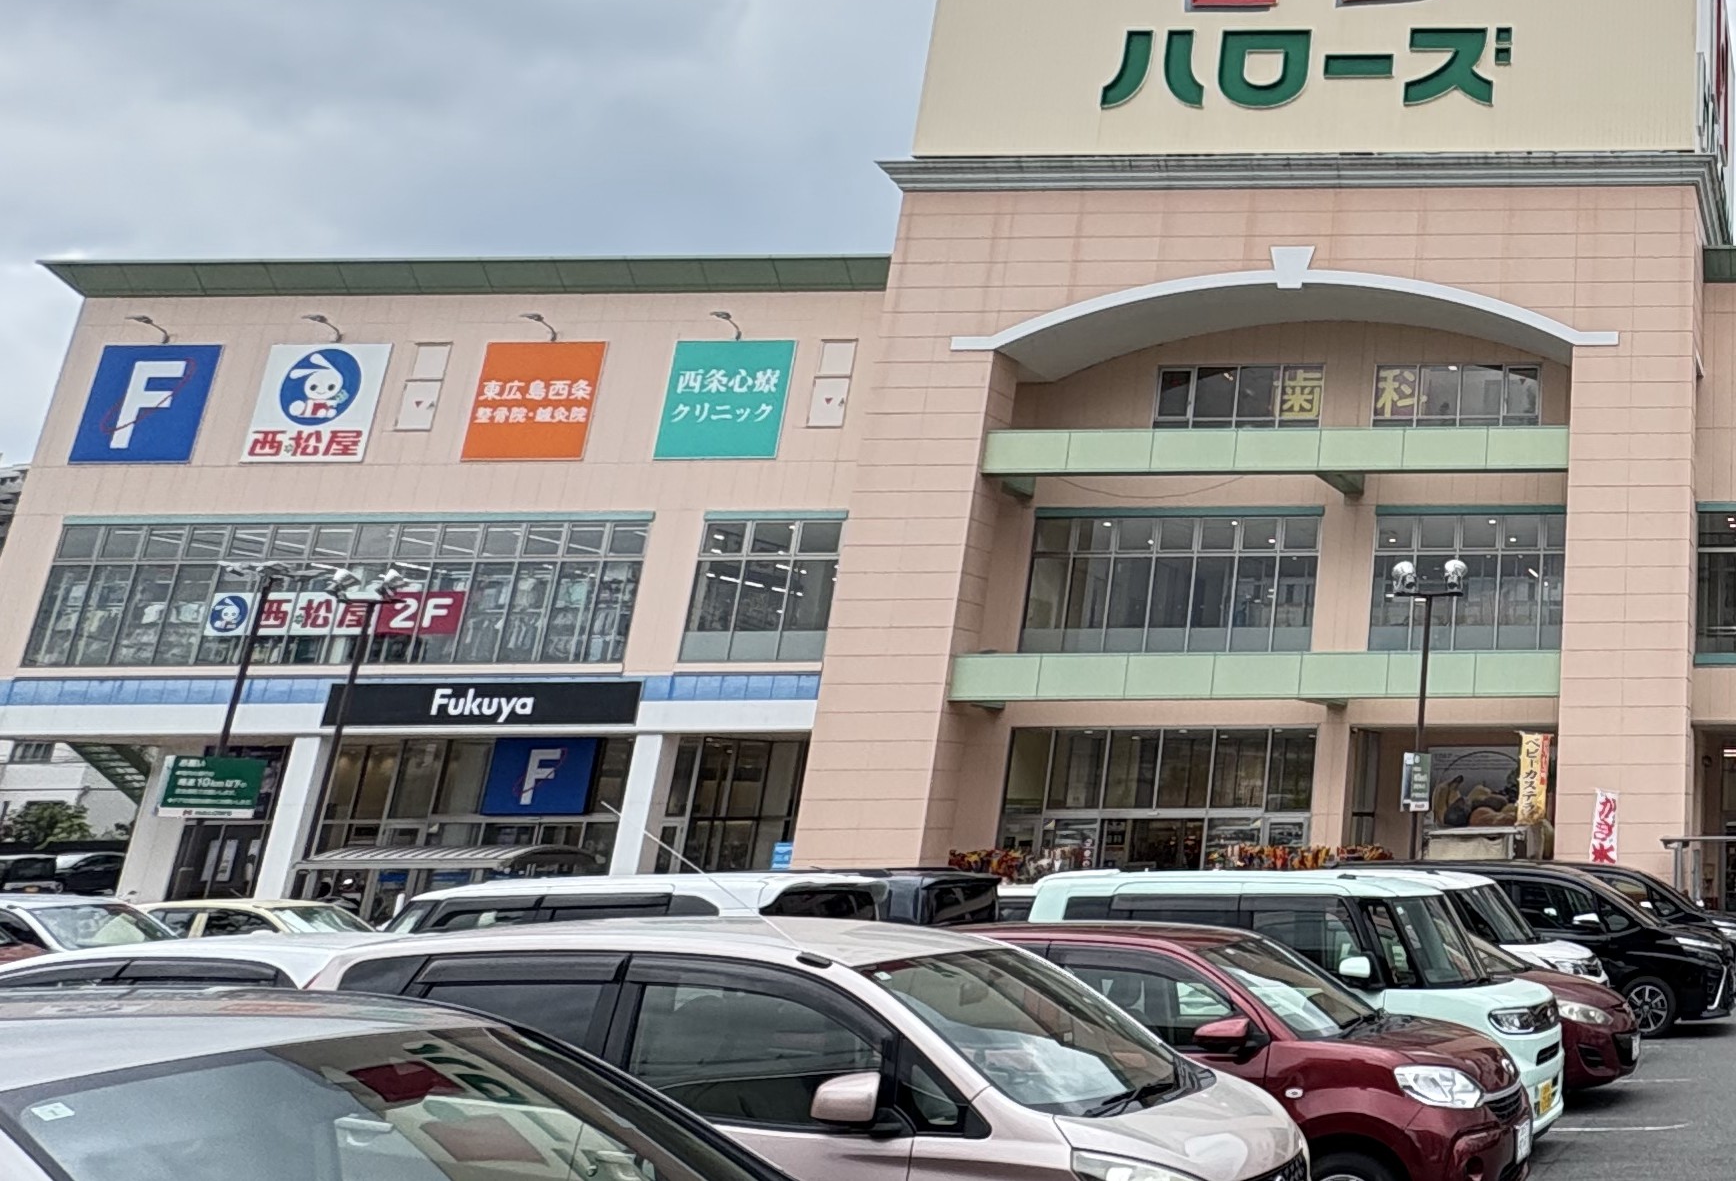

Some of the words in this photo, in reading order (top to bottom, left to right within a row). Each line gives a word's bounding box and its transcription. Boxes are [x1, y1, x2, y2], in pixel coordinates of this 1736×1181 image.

[1099, 27, 1512, 109] ハローズ
[478, 379, 592, 401] 東広島西条
[676, 368, 780, 394] 西条心療
[670, 402, 773, 423] クリニック
[248, 430, 363, 457] 西松屋
[389, 598, 453, 629] 2F
[430, 689, 535, 722] Fukuya
